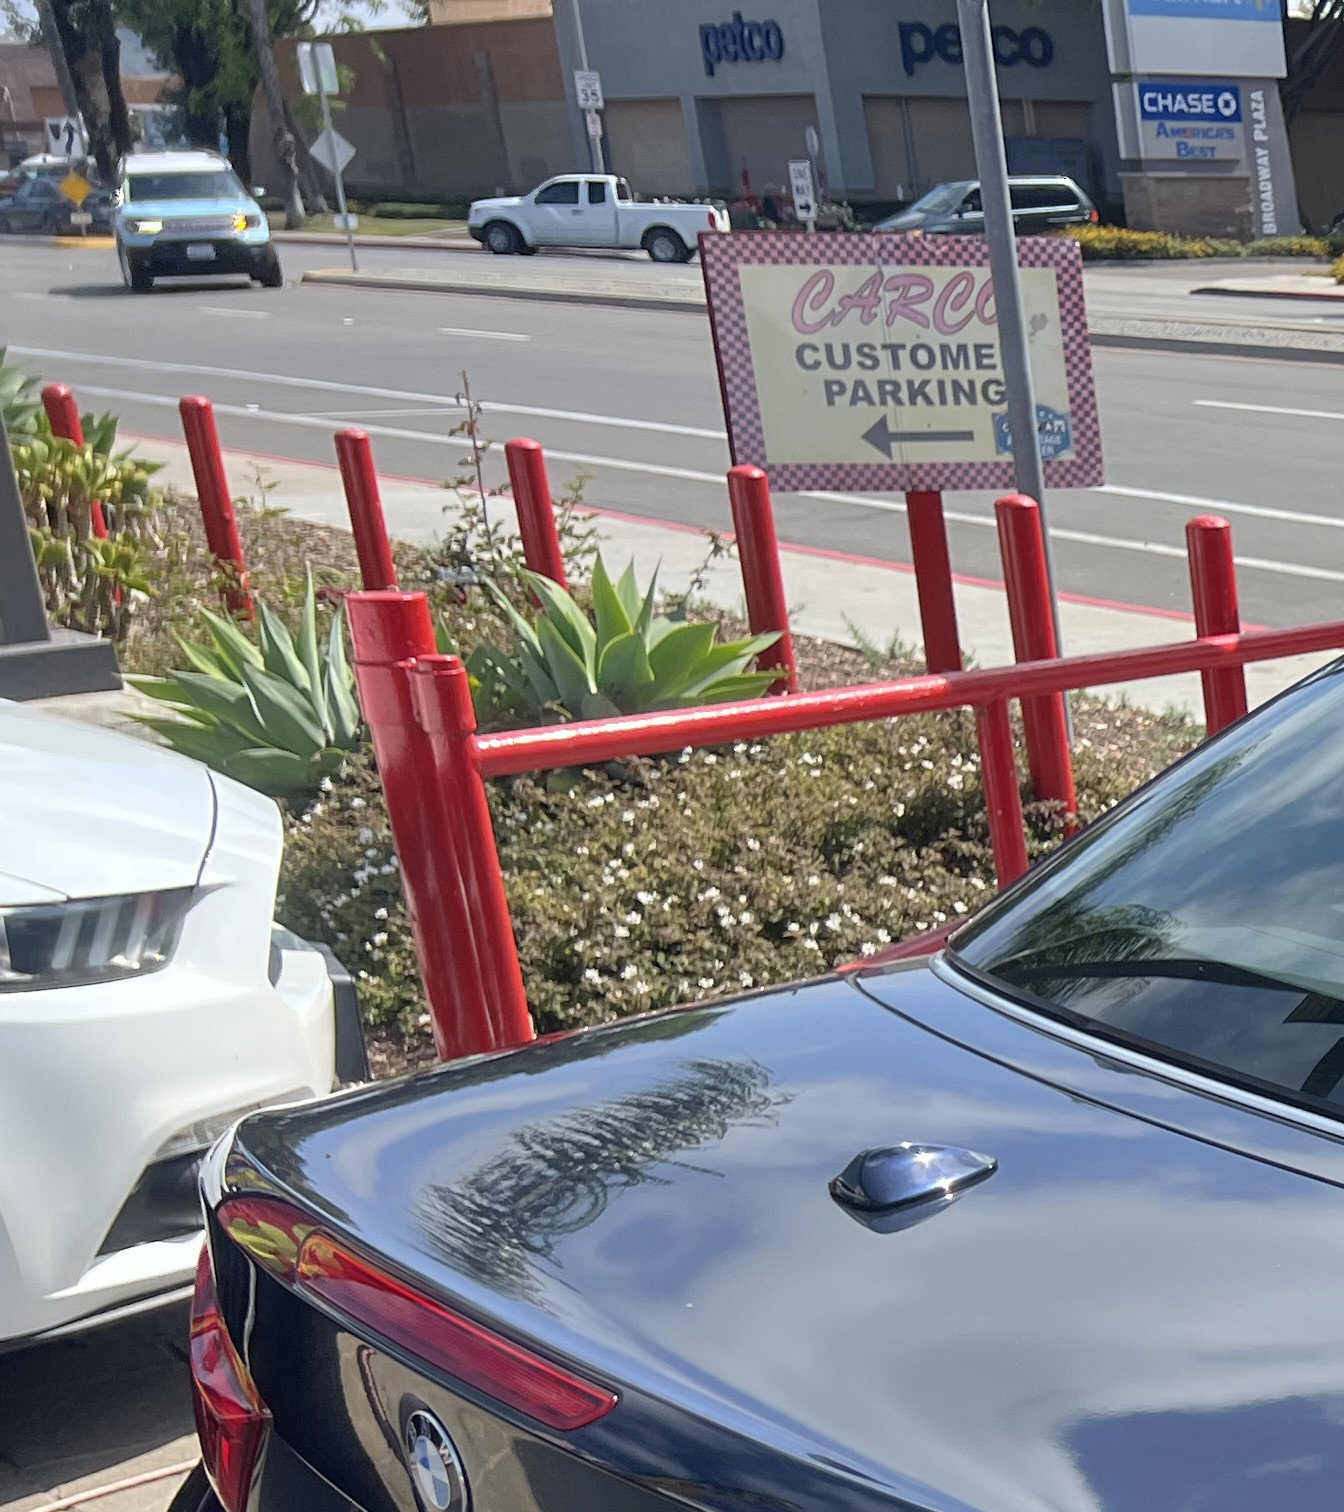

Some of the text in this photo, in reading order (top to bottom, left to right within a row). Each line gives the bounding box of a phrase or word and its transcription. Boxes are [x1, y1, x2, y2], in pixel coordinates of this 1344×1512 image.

[700, 11, 785, 77] petco
[897, 22, 1054, 77] peco
[1143, 91, 1216, 114] CHASE
[1251, 90, 1278, 235] BROADWAY PLAZA
[795, 342, 997, 371] CUSTOME
[824, 378, 1009, 407] PARKING
